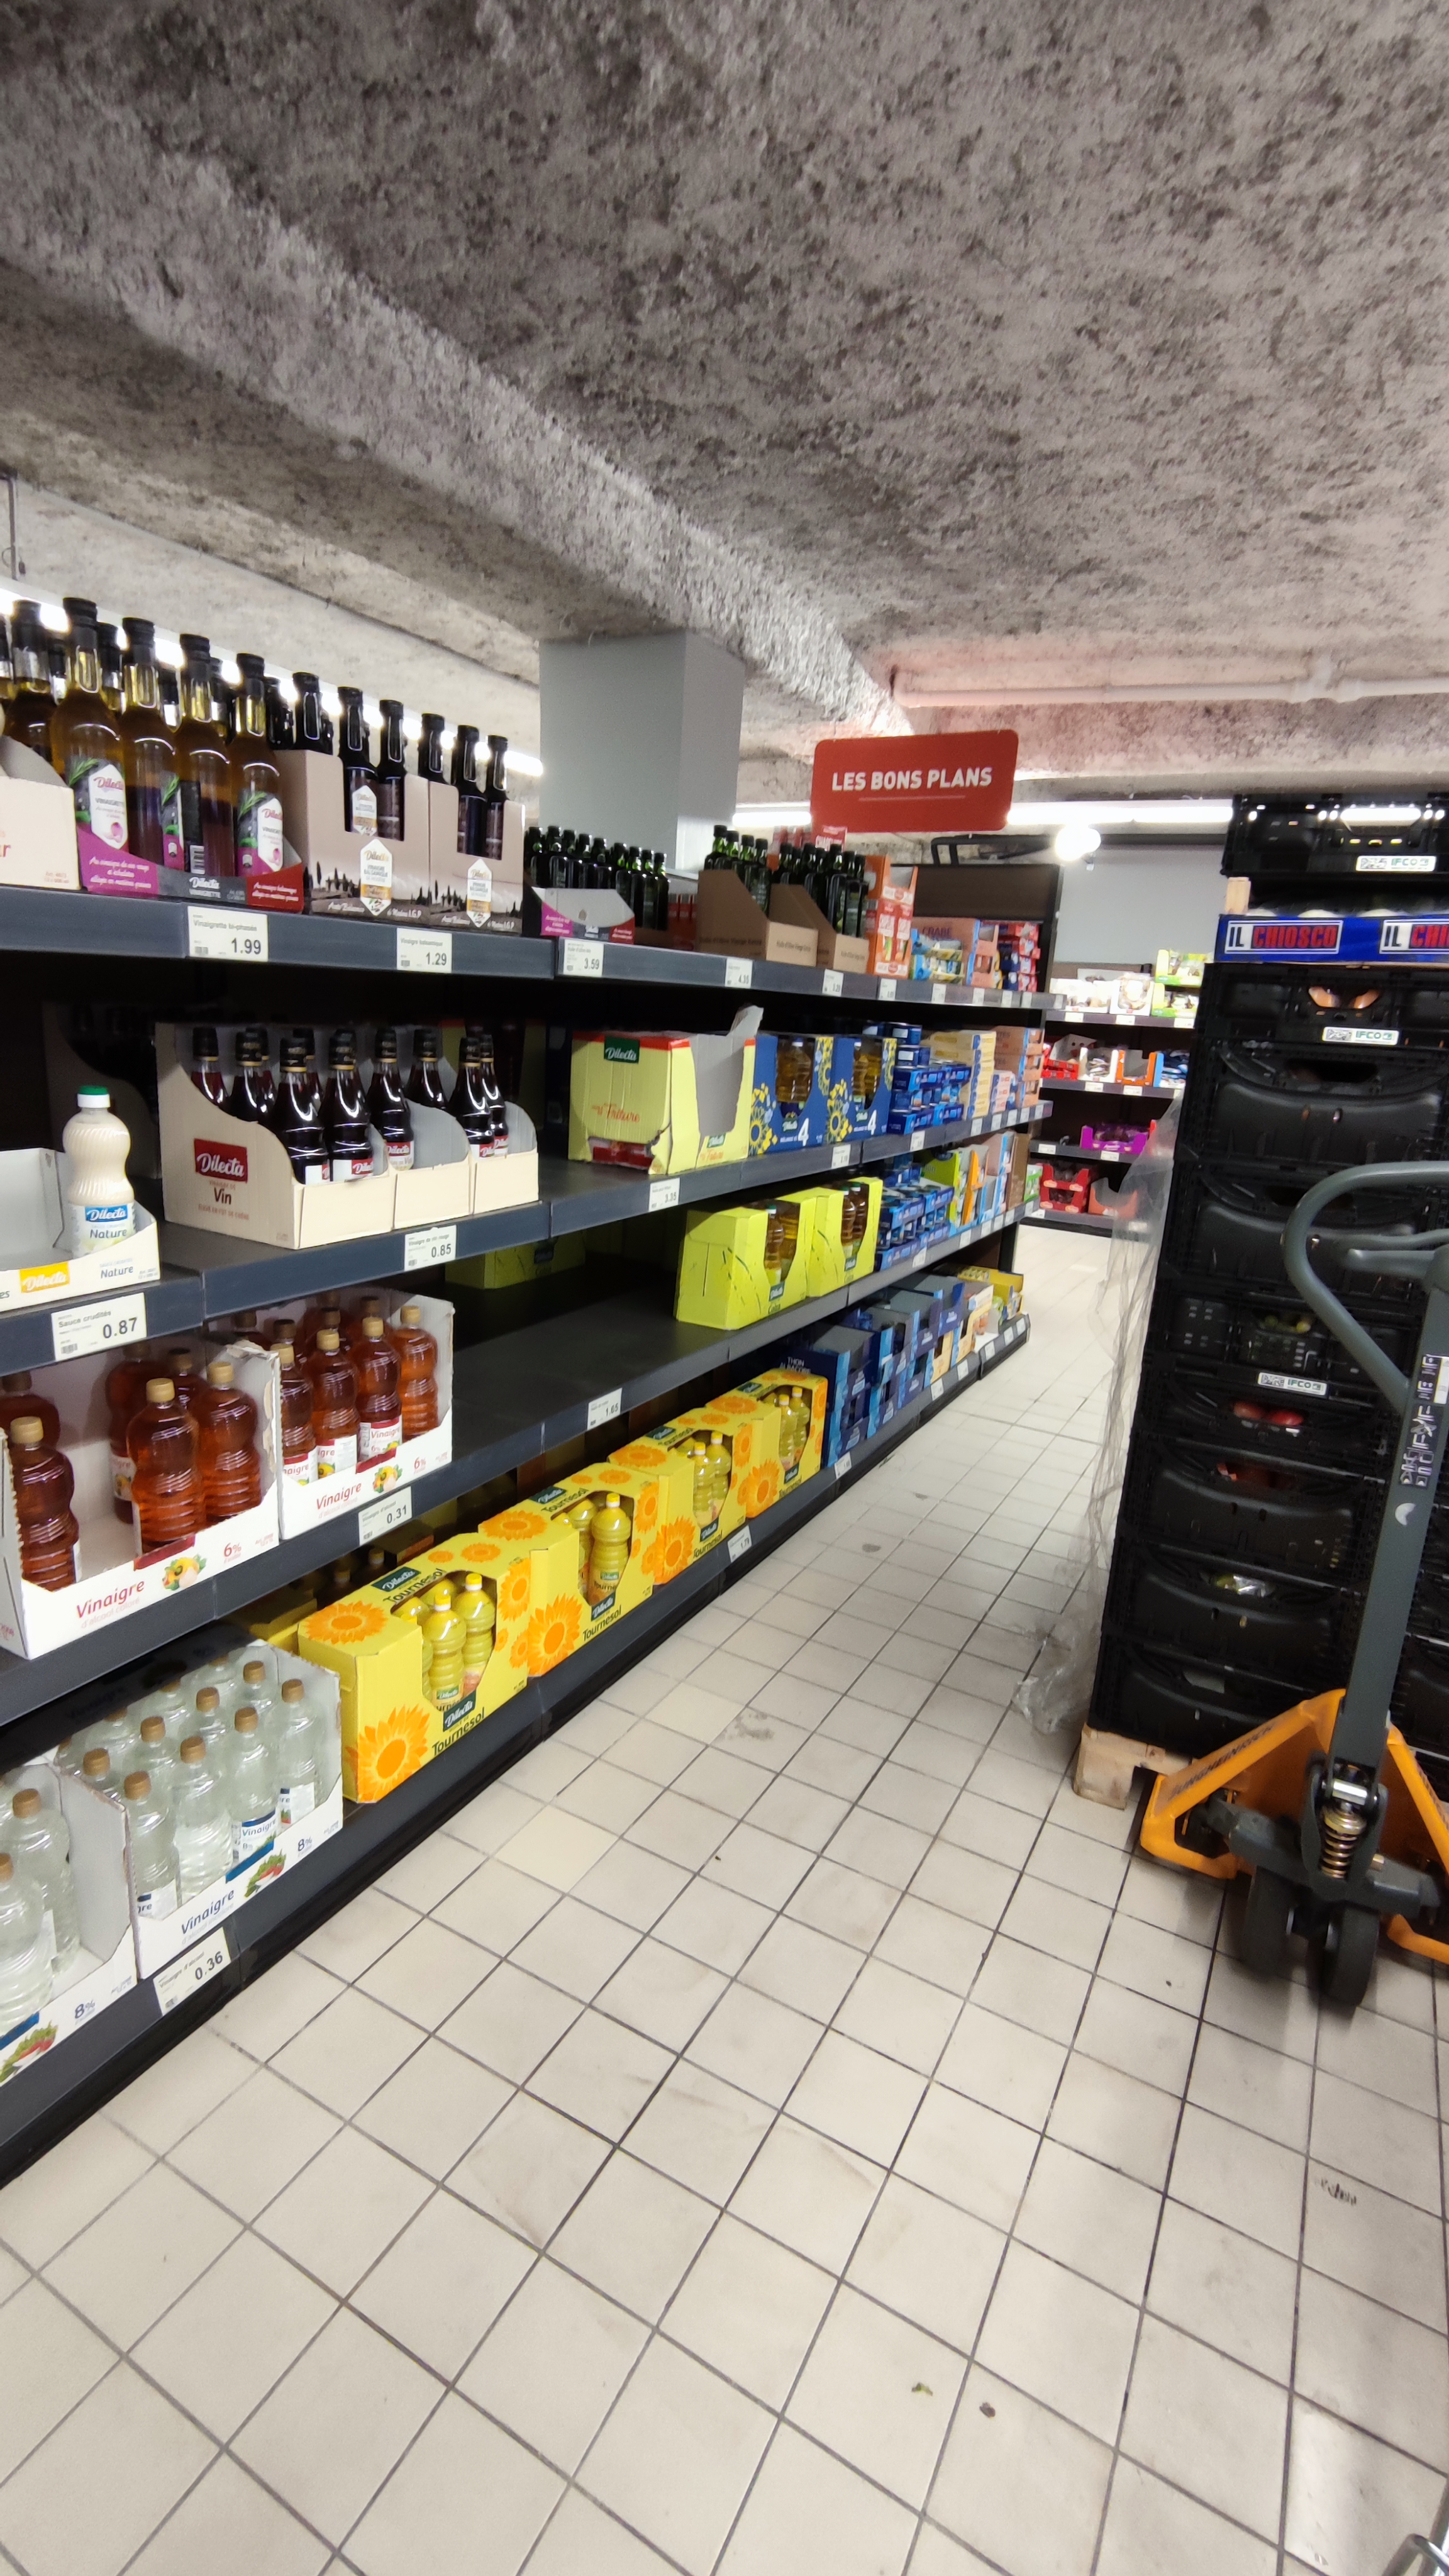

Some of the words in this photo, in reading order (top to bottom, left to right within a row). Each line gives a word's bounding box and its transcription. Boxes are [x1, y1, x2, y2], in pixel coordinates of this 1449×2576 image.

[831, 772, 866, 791] LES
[870, 770, 923, 790] BONS
[926, 767, 992, 788] PLANS
[1391, 858, 1418, 866] IFCO
[189, 877, 220, 889] Dilecta
[1230, 926, 1244, 948] IL
[1252, 925, 1338, 948] CHIOSCO
[1384, 925, 1402, 948] IL
[1411, 923, 1449, 948] CHI
[231, 937, 261, 955] 1.99
[426, 952, 447, 965] 1.29
[584, 958, 599, 969] 3.59
[1356, 1031, 1382, 1040] IFCO
[606, 1046, 636, 1062] Dilecta
[797, 1118, 809, 1146] 4
[868, 1109, 877, 1135] 4
[197, 1153, 244, 1177] Dilecta
[214, 1187, 231, 1205] Vin
[87, 1208, 126, 1221] Dilecta
[90, 1229, 128, 1238] Nature
[431, 1243, 452, 1258] 0.85
[22, 1271, 67, 1291] Dilecta
[101, 1266, 133, 1279] Nature
[58, 1318, 80, 1328] Sauce
[83, 1311, 111, 1321] crudités
[103, 1317, 138, 1339] 0.87
[787, 1357, 804, 1367] THON
[1288, 1379, 1311, 1389] IFCO
[414, 1457, 426, 1470] 6%
[316, 1482, 362, 1510] Vinaigre
[387, 1505, 407, 1524] 0.31
[224, 1542, 242, 1557] 6%
[693, 1530, 723, 1558] Tournesol
[382, 1570, 416, 1591] Dilecta
[383, 1568, 443, 1603] Tournesol
[76, 1580, 145, 1619] Vinaigre
[81, 1610, 114, 1629] d'alcool
[116, 1598, 140, 1614] coloré
[582, 1604, 622, 1641] Tournesol
[445, 1700, 473, 1728] Dilecta
[432, 1706, 485, 1756] Tournesol
[298, 1836, 313, 1852] 8%
[181, 1890, 234, 1935] Vinaigre
[195, 1951, 223, 1980] 0.36
[74, 1999, 96, 2019] 8%
